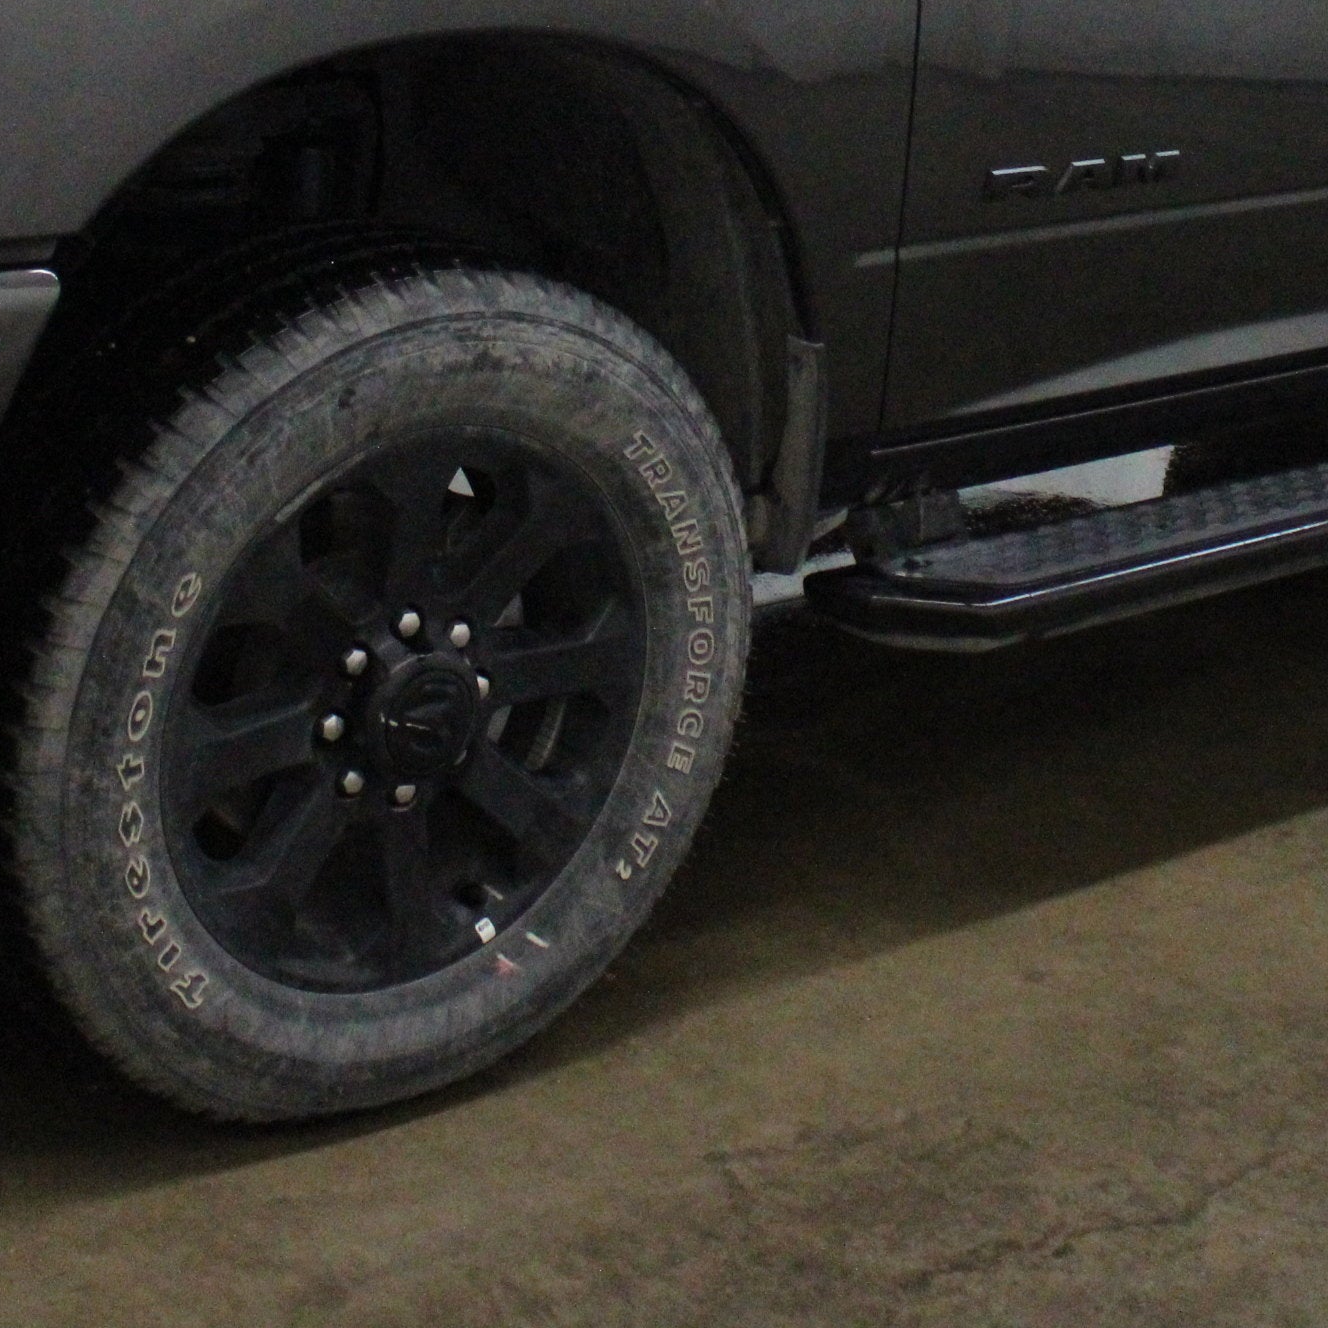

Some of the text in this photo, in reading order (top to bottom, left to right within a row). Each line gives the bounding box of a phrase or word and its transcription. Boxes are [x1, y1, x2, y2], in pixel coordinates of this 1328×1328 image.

[981, 149, 1182, 200] RAM
[622, 429, 716, 774] TRANSFORCE
[117, 571, 210, 1010] Firestone
